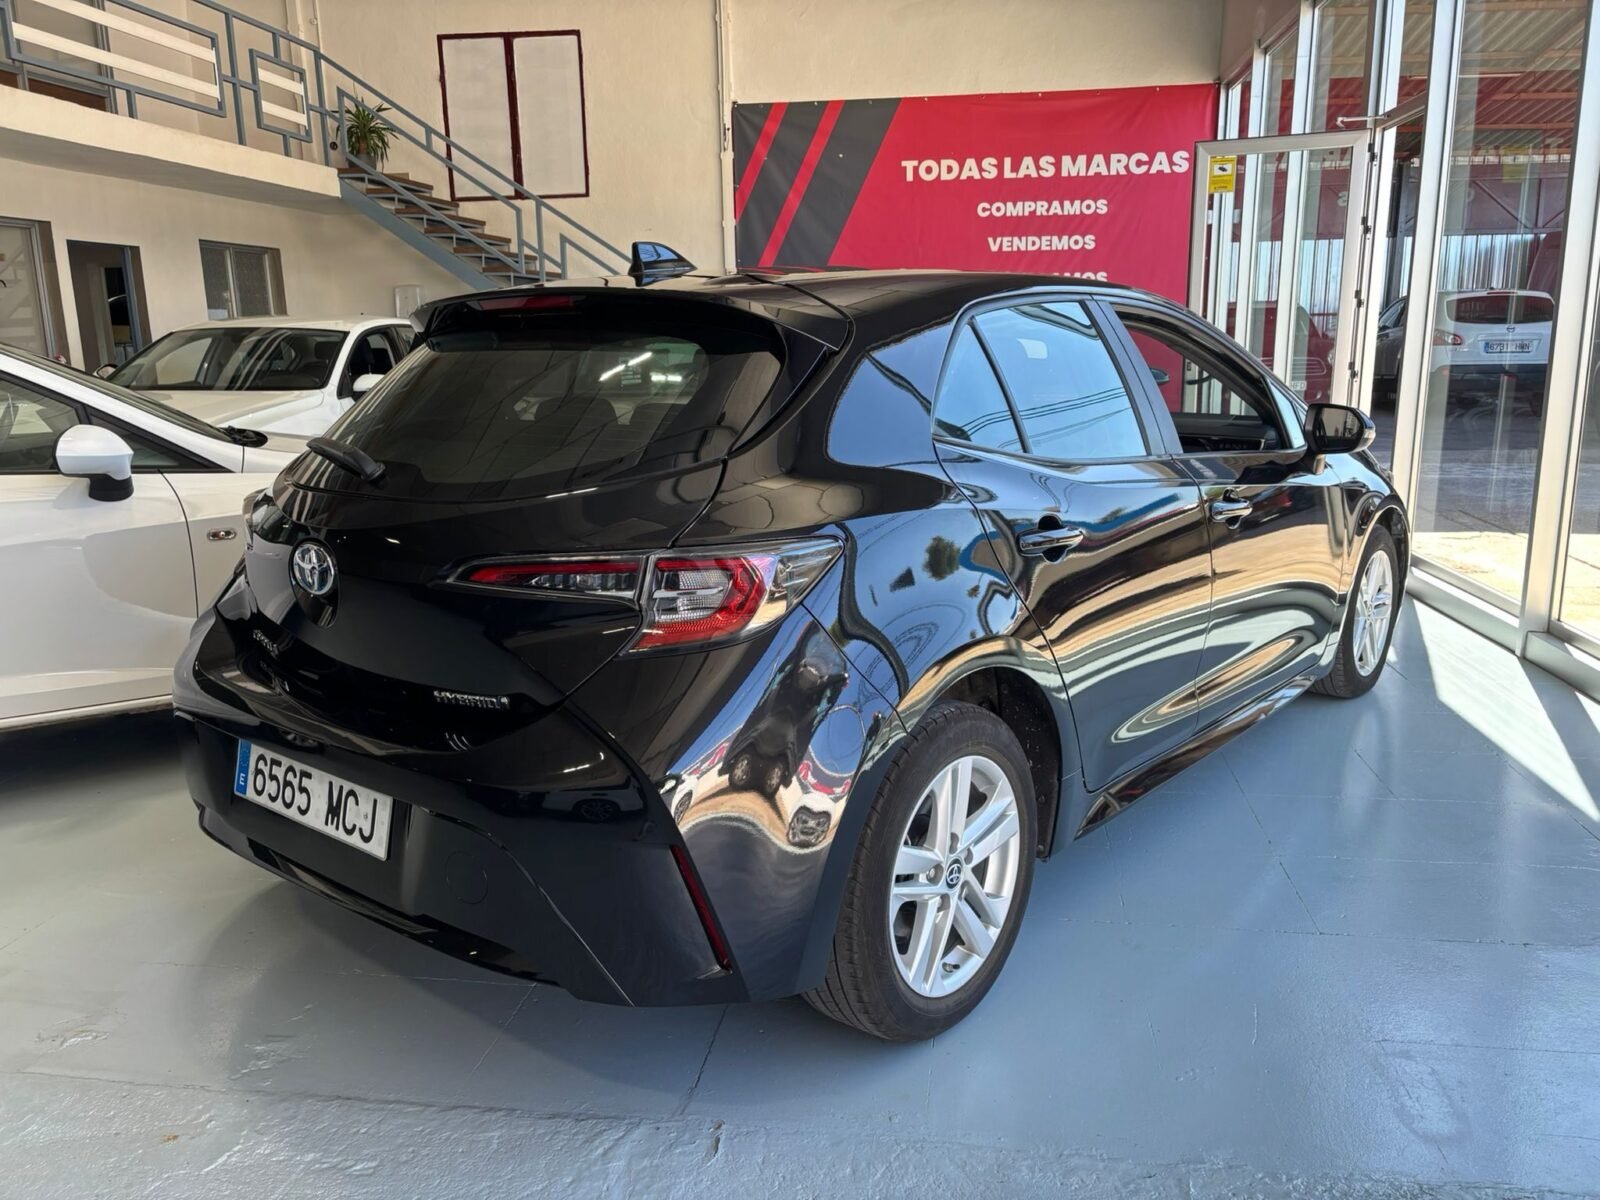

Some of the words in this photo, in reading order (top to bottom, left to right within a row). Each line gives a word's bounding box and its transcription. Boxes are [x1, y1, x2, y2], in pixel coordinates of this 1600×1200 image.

[901, 157, 998, 182] TODAS
[1003, 155, 1056, 178] LAS
[1061, 150, 1190, 177] MARCAS
[977, 198, 1108, 218] COMPRAMOS
[987, 234, 1096, 252] VENDEMOS
[253, 753, 313, 816] 6565
[324, 780, 378, 844] MCJ
